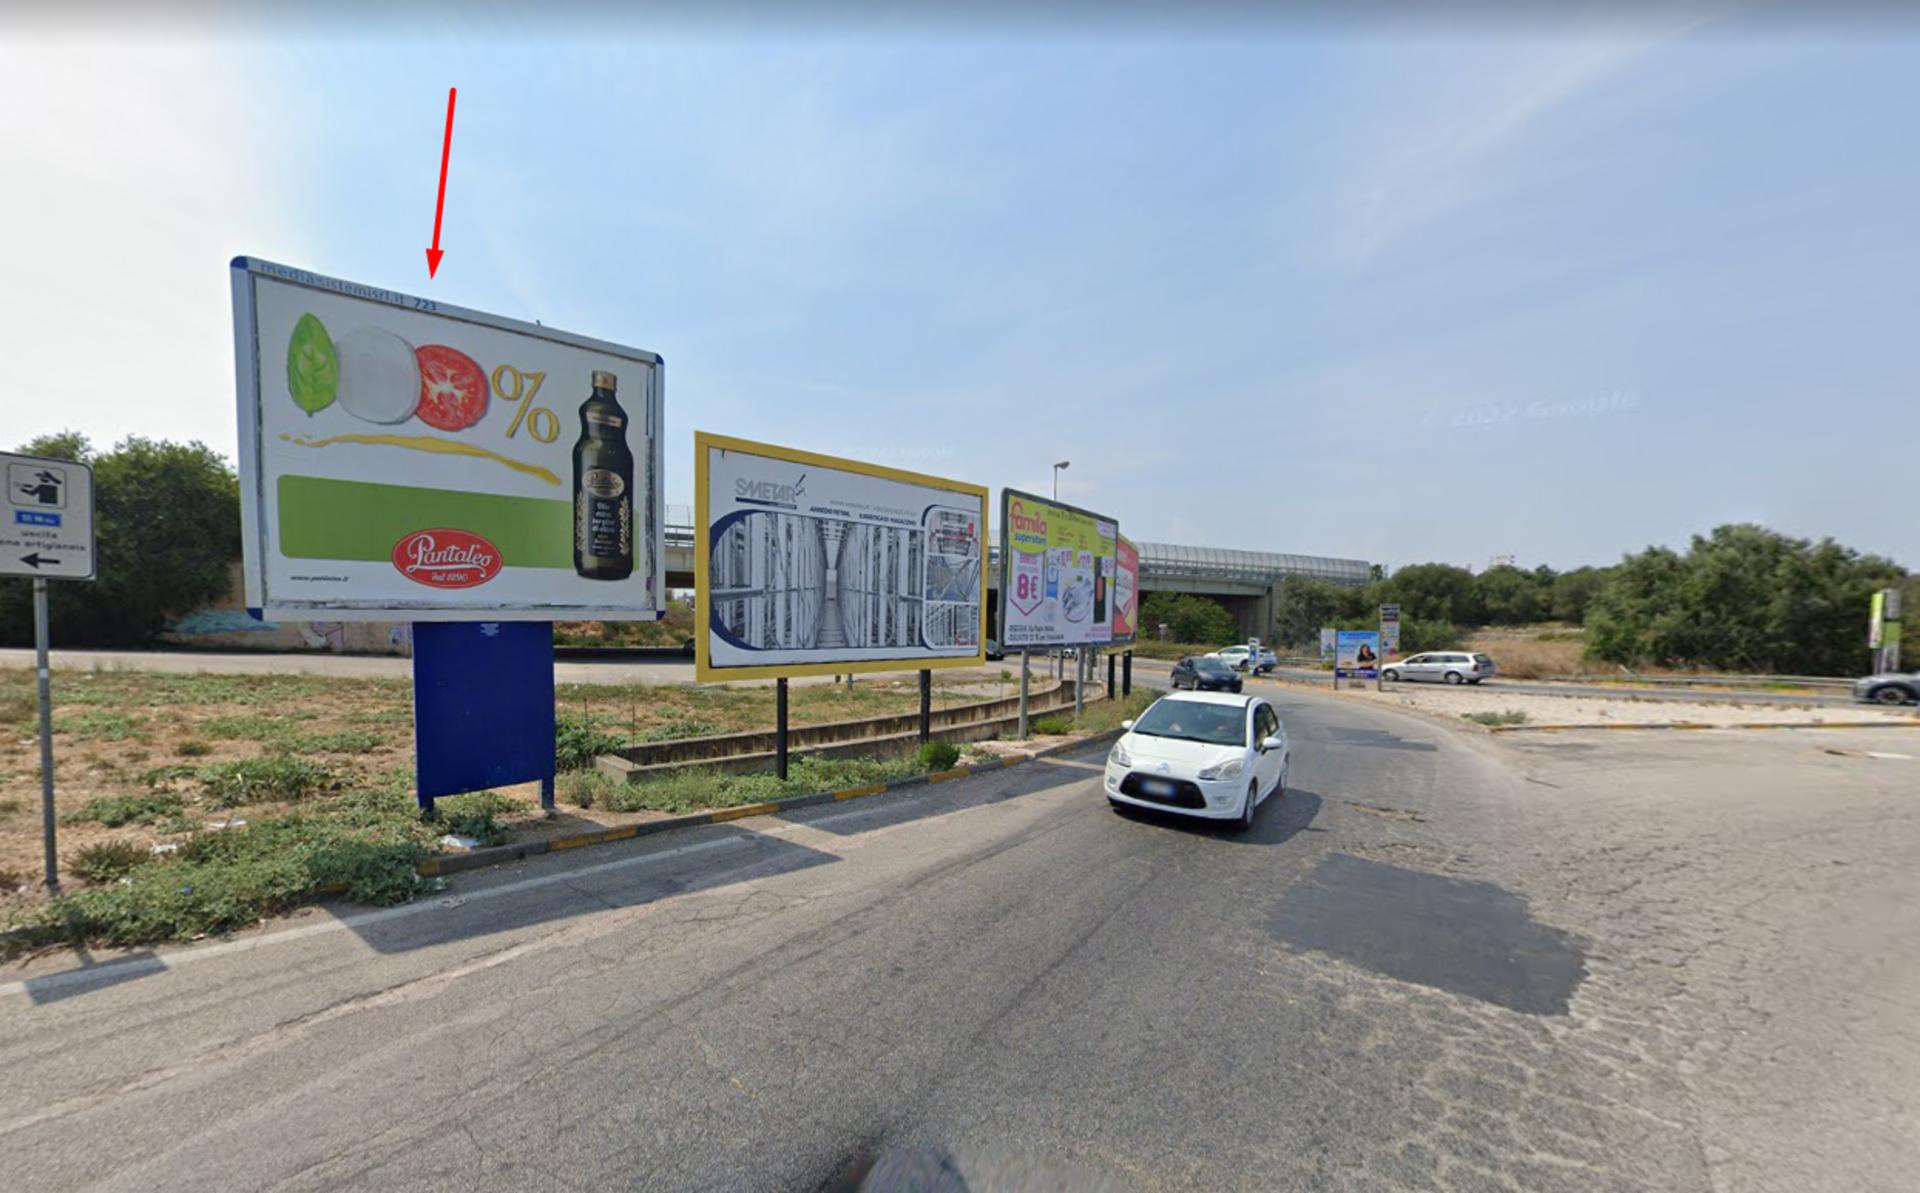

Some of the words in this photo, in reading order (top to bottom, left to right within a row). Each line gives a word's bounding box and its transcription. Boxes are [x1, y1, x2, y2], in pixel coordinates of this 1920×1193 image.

[413, 297, 437, 311] 723
[491, 363, 561, 444] %
[735, 478, 797, 503] SMETAR
[21, 531, 57, 539] uscita
[24, 541, 86, 551] artigianale
[405, 533, 494, 572] Pantaleo
